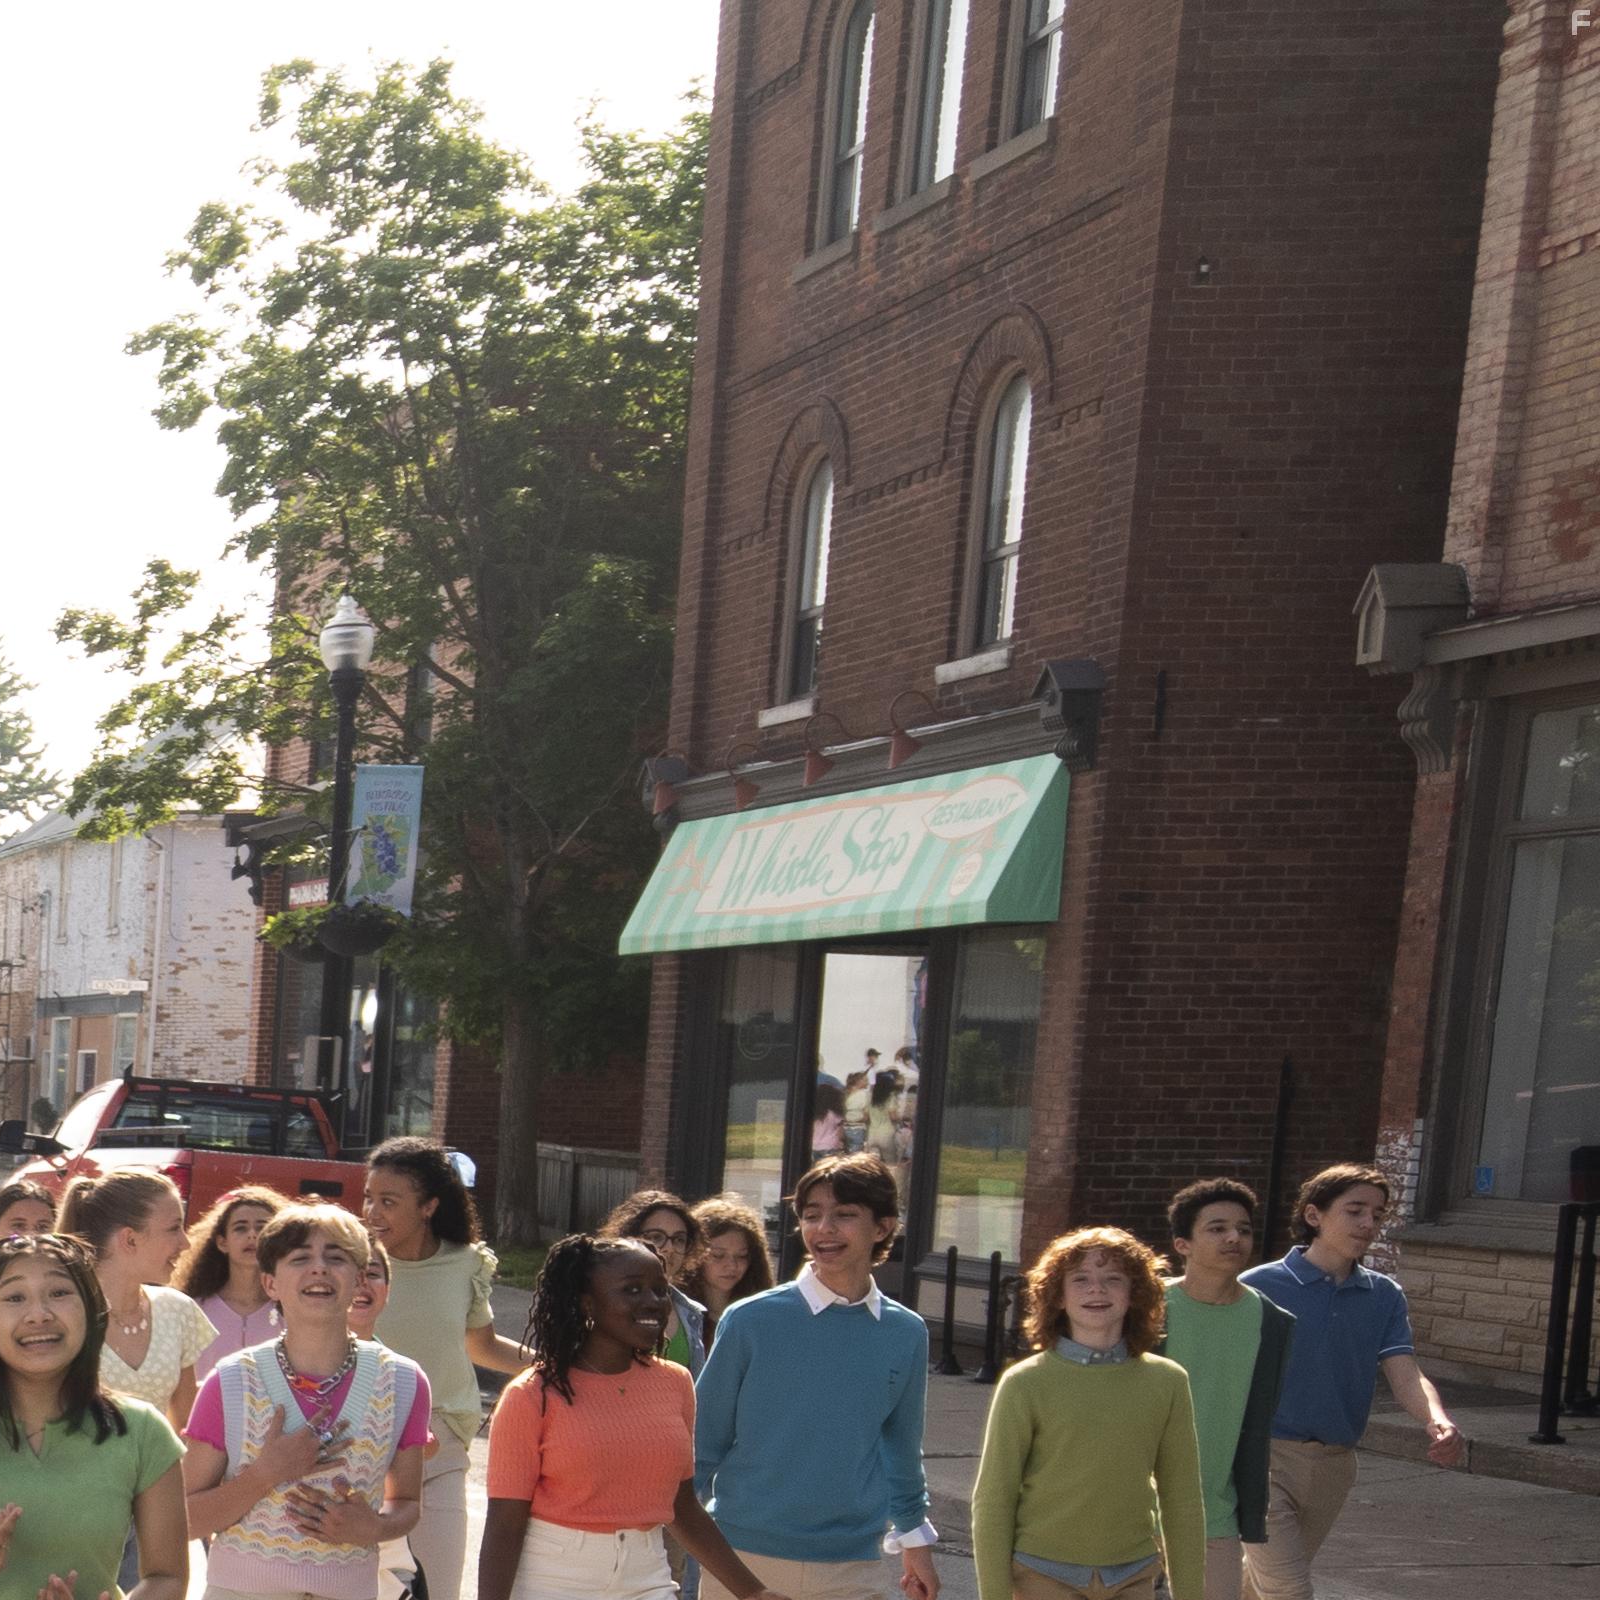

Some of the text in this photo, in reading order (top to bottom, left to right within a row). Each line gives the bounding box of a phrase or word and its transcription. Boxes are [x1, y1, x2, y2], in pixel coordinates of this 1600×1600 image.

[928, 792, 1019, 826] RESTAURANT
[717, 806, 911, 910] Whistle Stop
